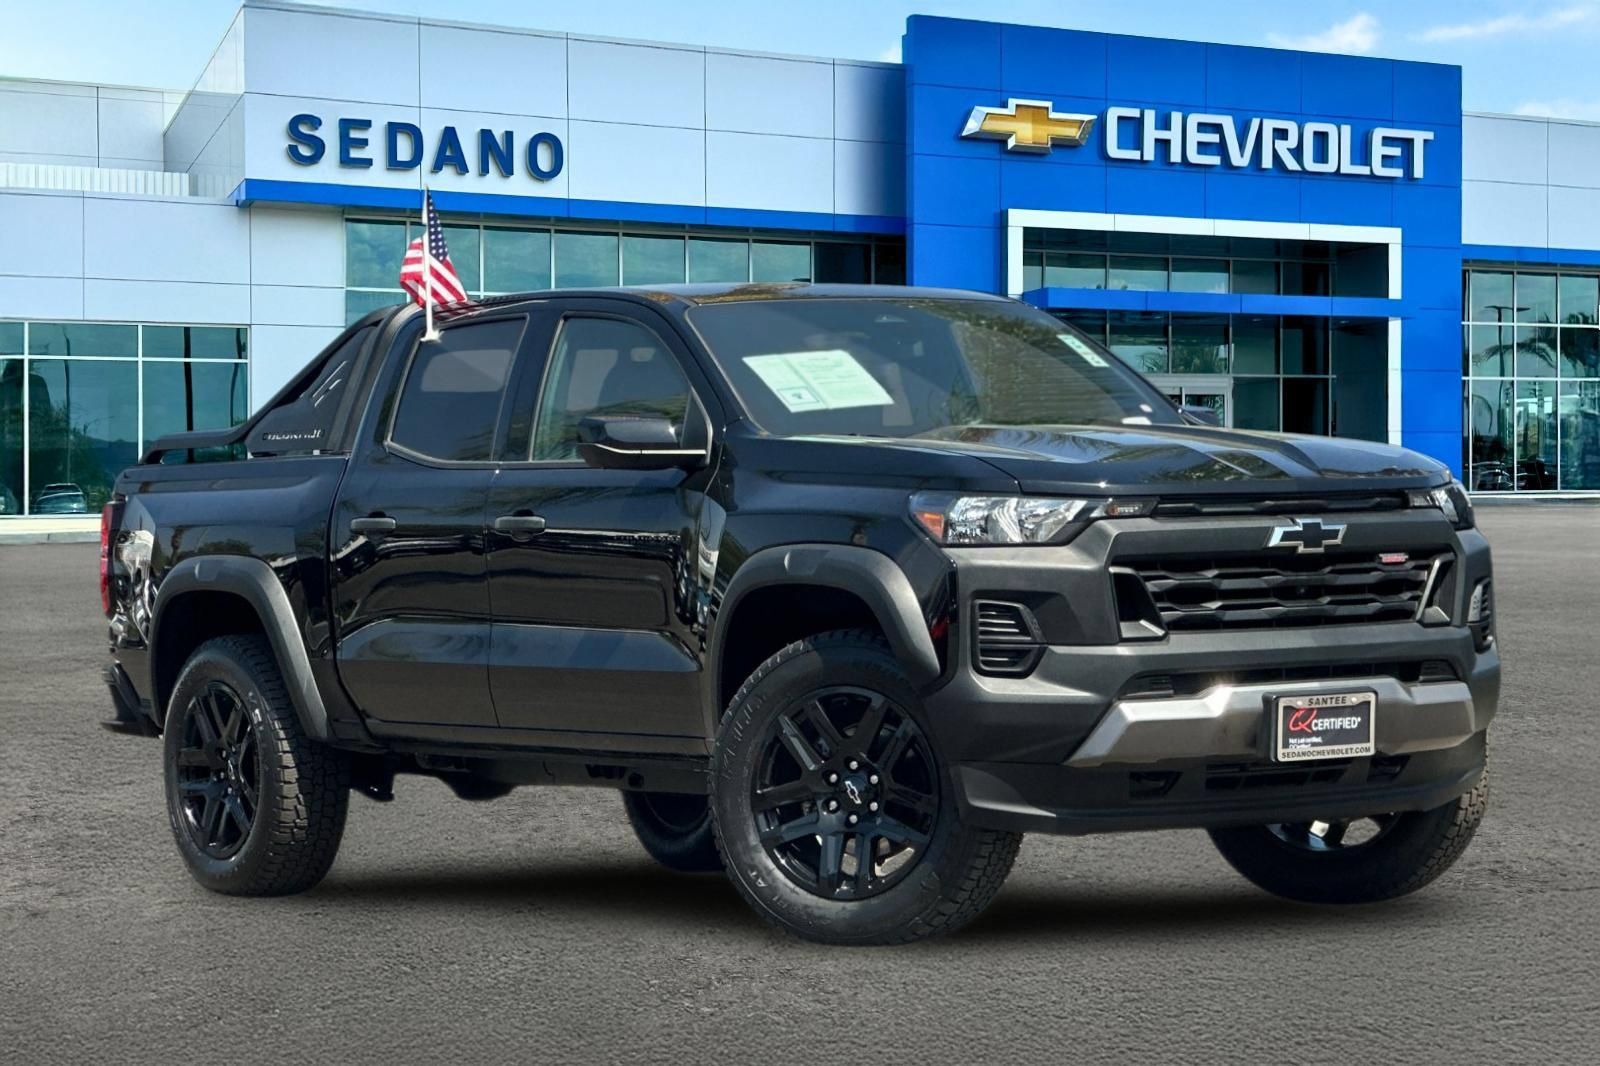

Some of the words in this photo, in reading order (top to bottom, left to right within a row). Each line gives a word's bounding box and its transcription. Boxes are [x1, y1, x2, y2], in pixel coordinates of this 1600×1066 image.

[286, 113, 565, 182] SEDANO
[1105, 105, 1435, 180] CHEVROLET
[1308, 696, 1347, 705] SANTEE
[1281, 746, 1371, 758] SEDANOCHEVROLET.COM
